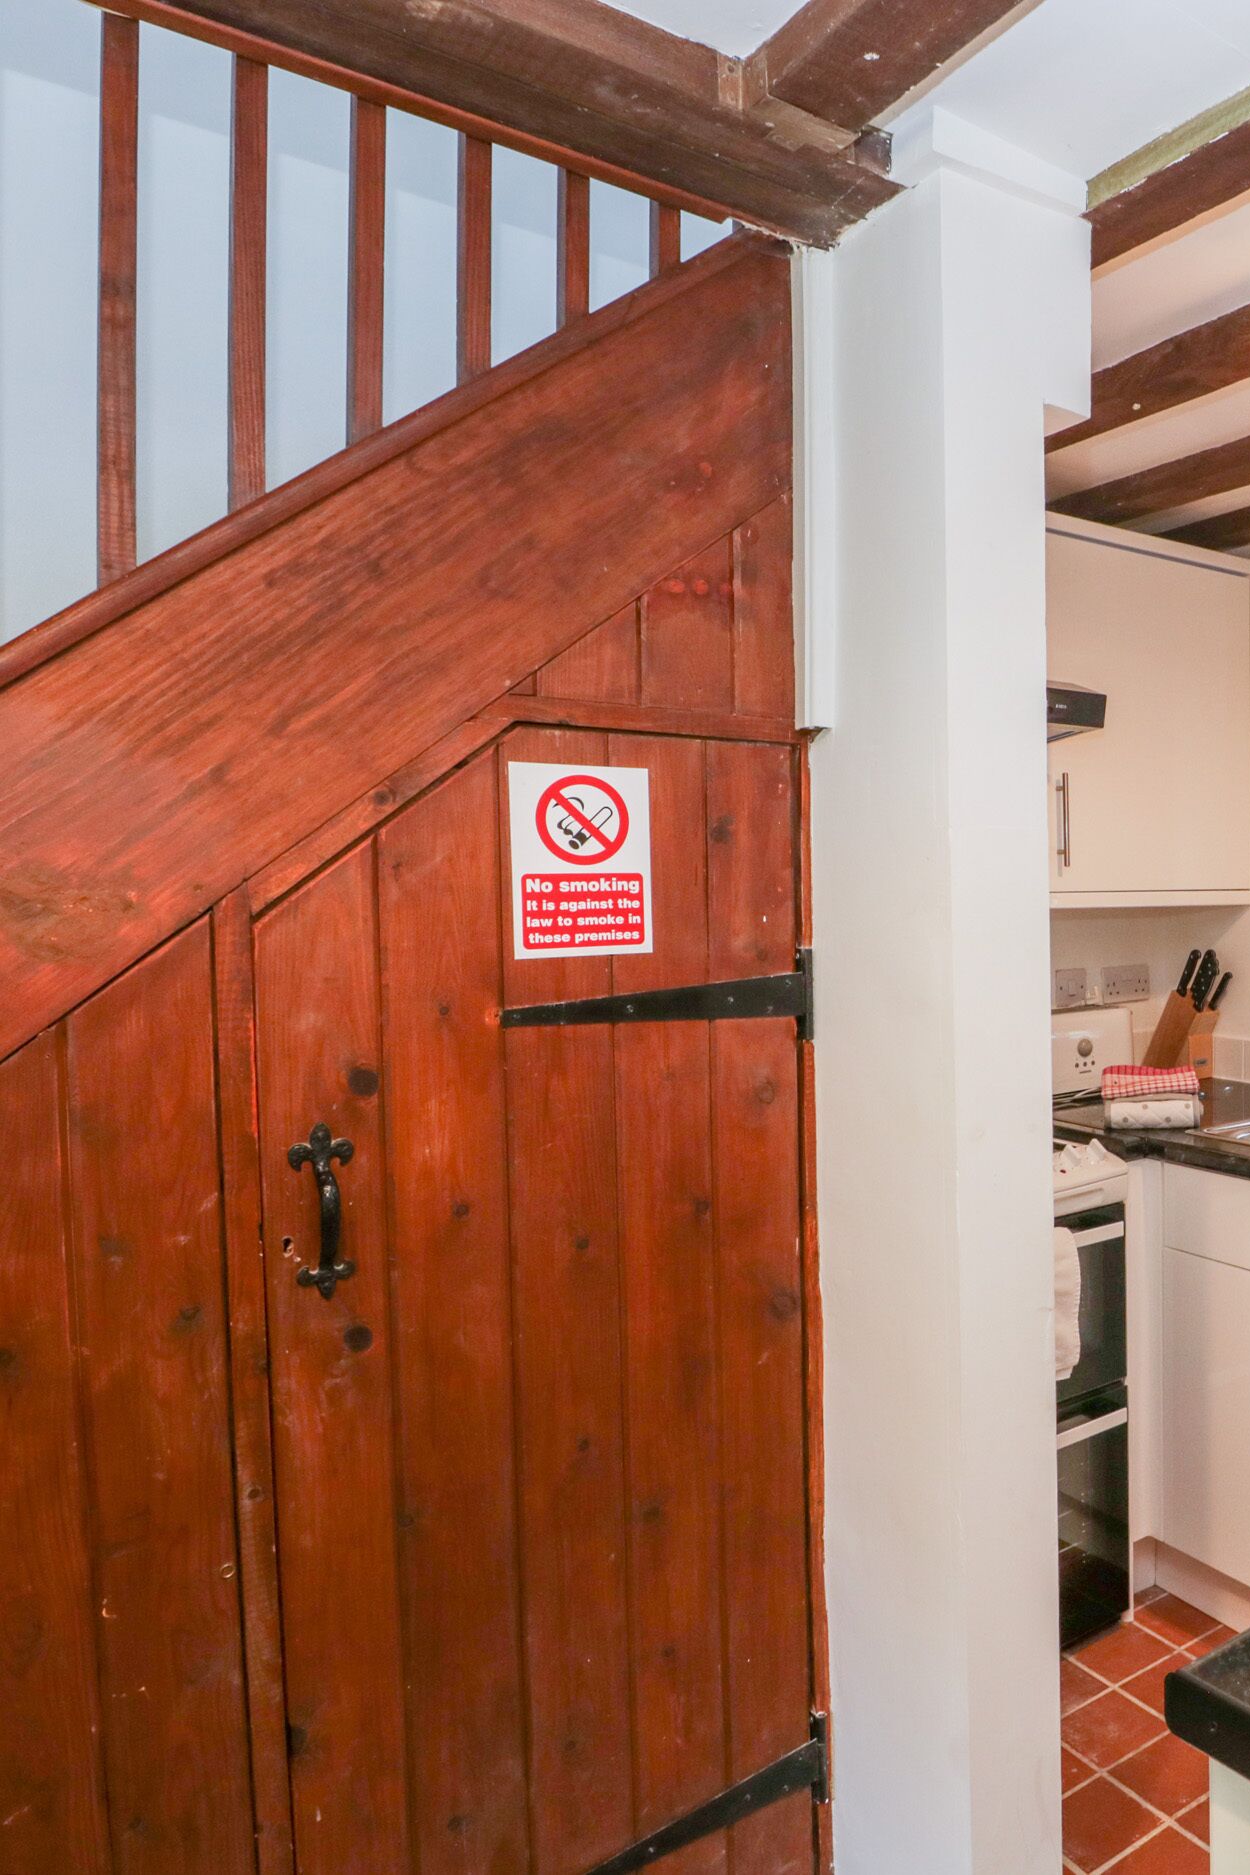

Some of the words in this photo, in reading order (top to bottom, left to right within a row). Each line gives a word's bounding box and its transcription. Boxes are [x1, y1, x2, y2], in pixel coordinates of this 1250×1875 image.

[526, 878, 553, 893] No
[559, 877, 640, 894] smoking
[526, 900, 538, 911] It
[542, 899, 555, 911] is
[559, 898, 614, 912] against
[617, 898, 640, 909] the
[526, 916, 553, 927] law
[557, 916, 572, 926] to
[577, 914, 624, 926] smoke
[628, 913, 641, 924] in
[528, 932, 571, 944] these
[575, 929, 640, 944] premises
